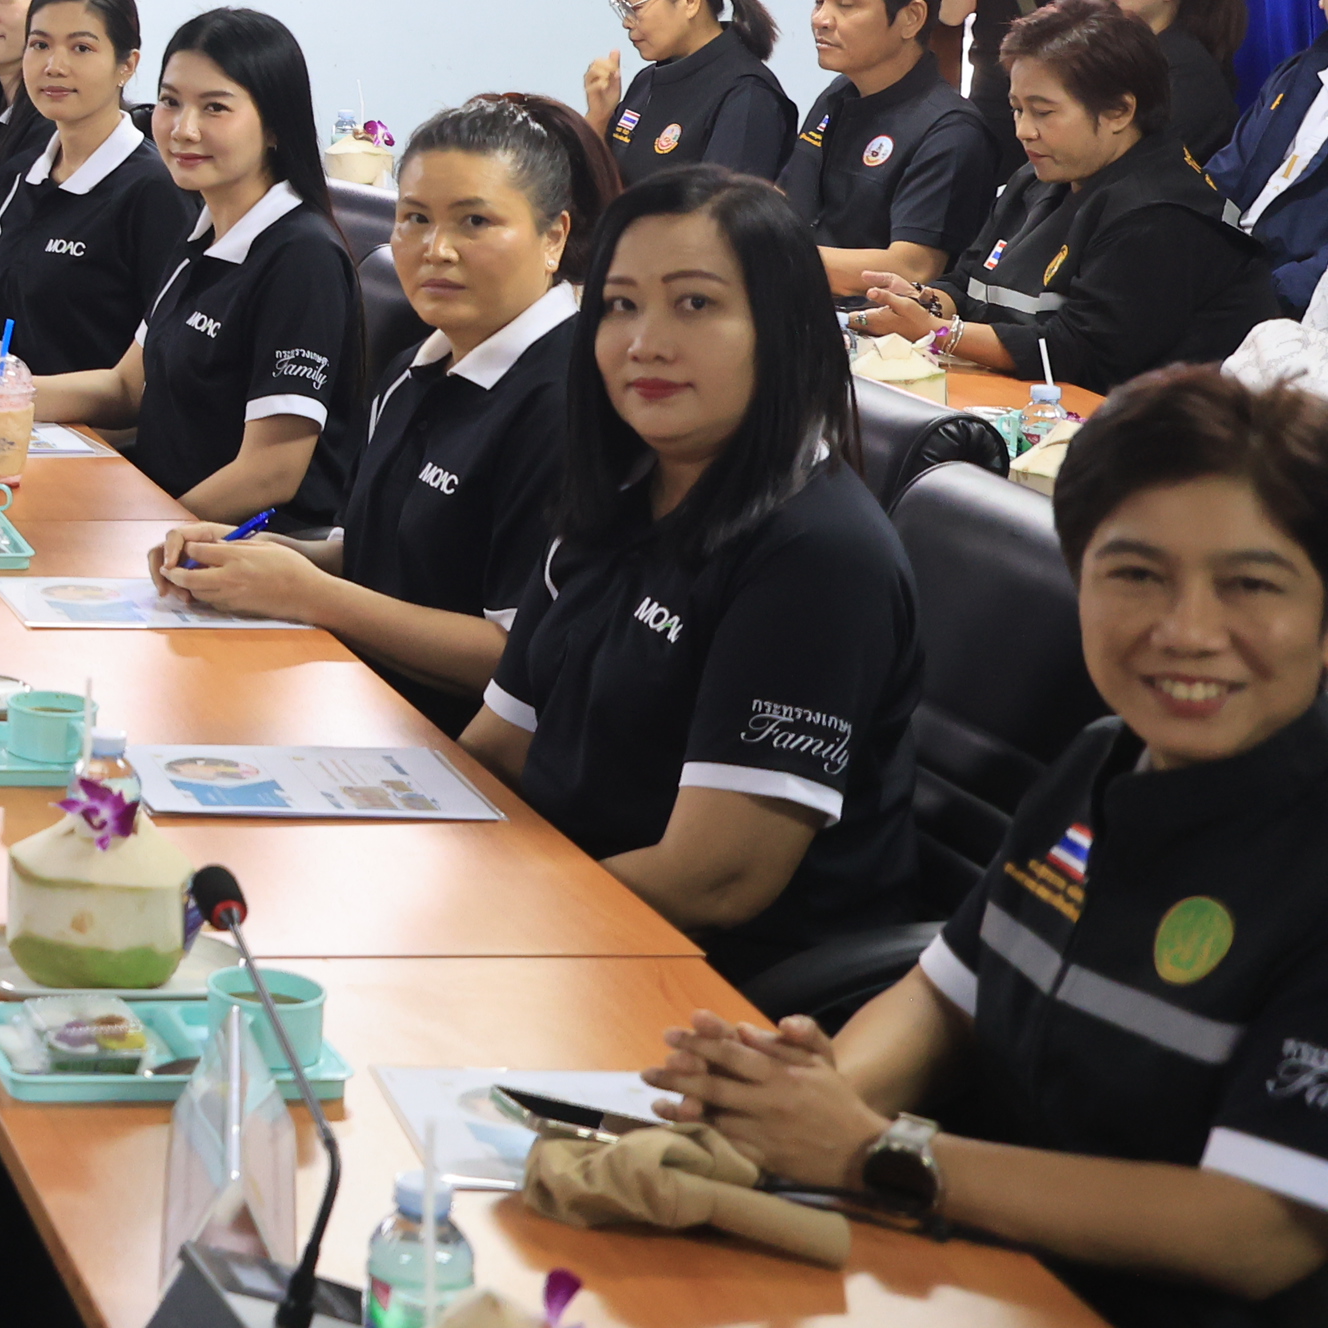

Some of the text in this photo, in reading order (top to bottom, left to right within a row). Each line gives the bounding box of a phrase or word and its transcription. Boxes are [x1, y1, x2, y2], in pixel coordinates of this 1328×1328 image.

[44, 238, 87, 256] MOAC
[185, 311, 222, 339] MOAC
[272, 356, 328, 390] Family
[418, 461, 459, 495] MOAC
[740, 713, 852, 775] Family
